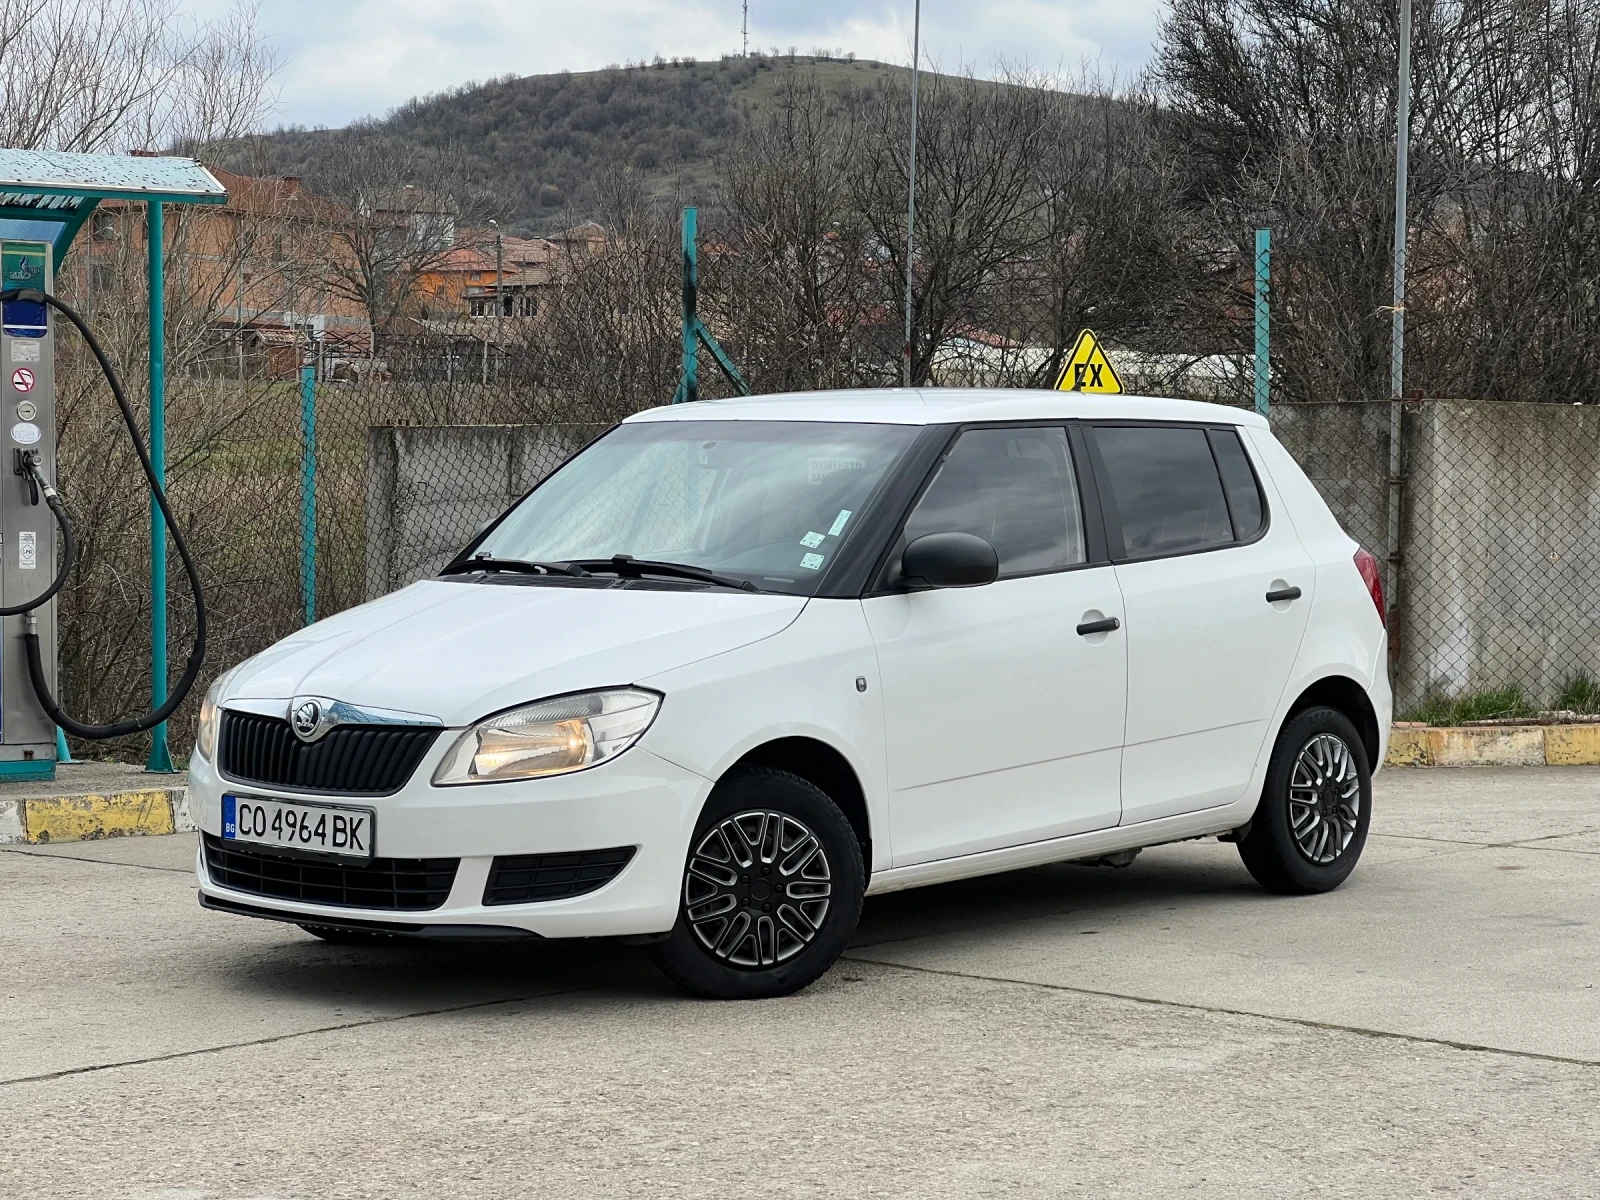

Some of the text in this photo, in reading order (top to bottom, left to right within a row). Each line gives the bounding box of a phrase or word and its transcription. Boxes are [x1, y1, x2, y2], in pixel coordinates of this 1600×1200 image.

[1075, 363, 1104, 387] EX
[225, 822, 235, 833] BG
[239, 804, 364, 850] CO 4964 BK
